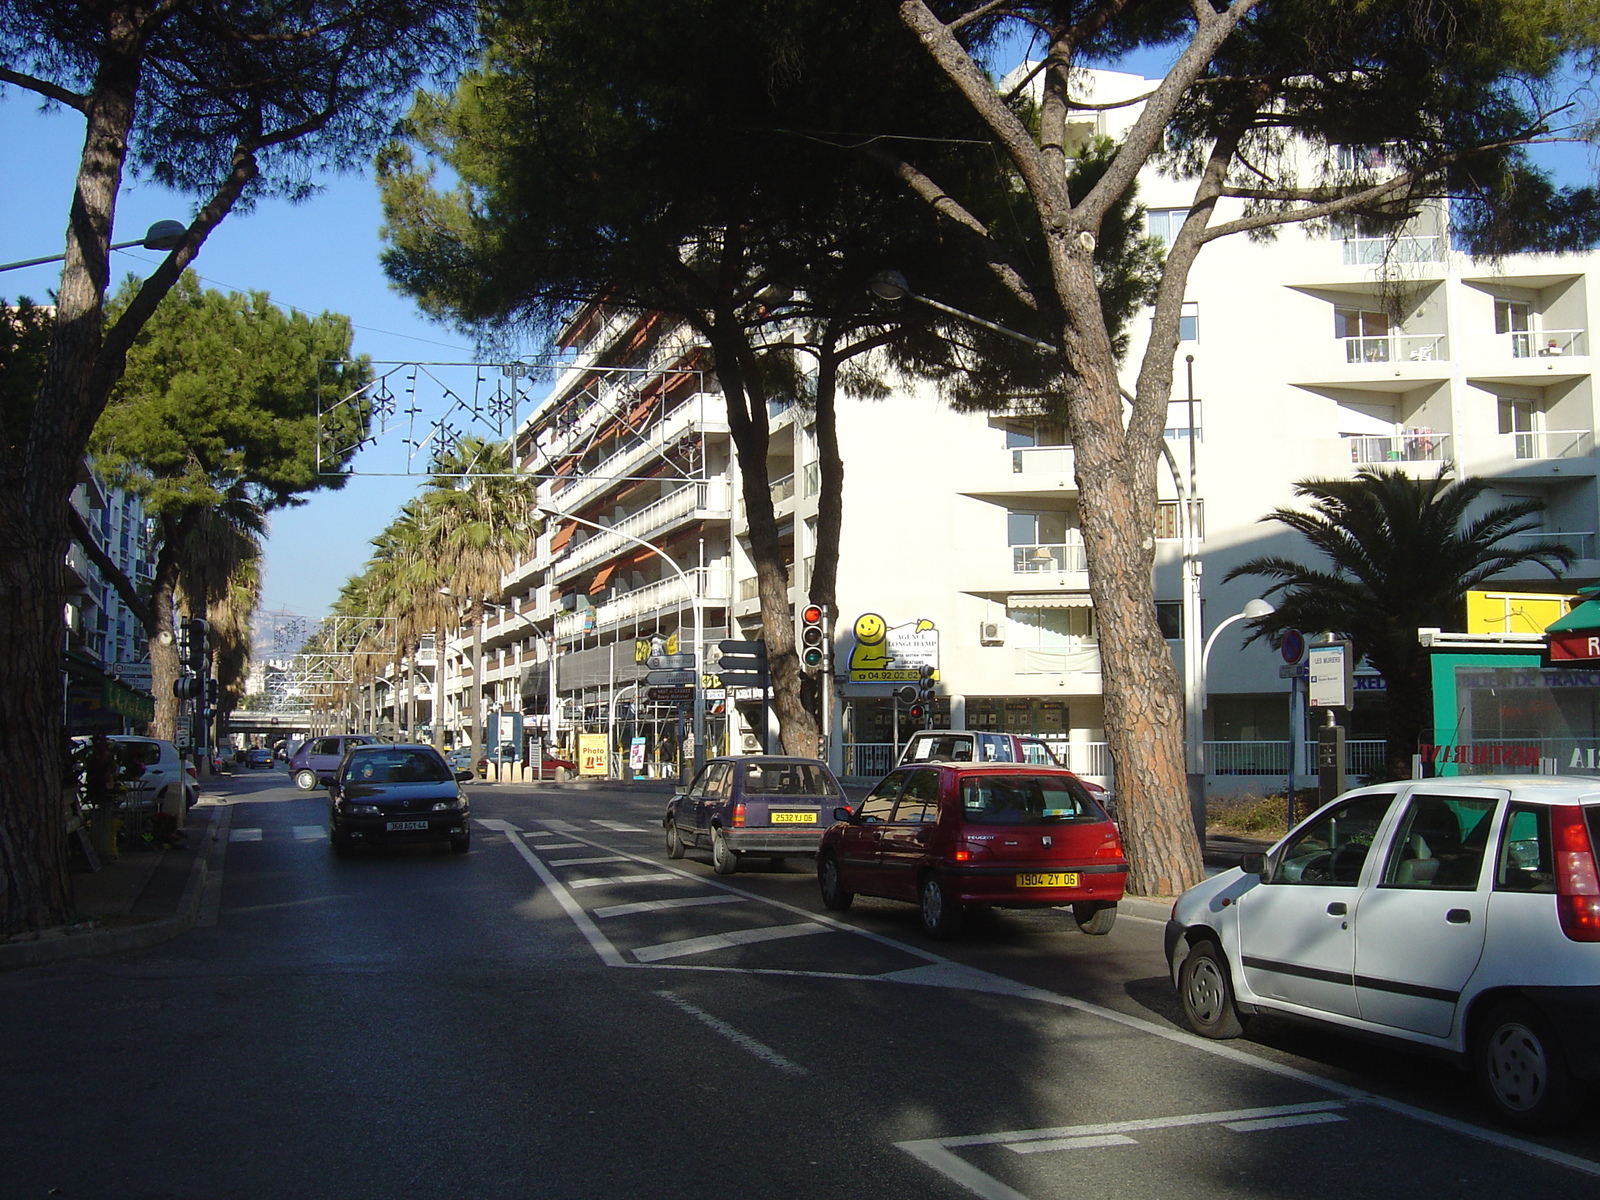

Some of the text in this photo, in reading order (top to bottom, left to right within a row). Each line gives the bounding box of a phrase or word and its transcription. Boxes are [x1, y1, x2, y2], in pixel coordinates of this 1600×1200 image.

[1314, 657, 1323, 665] LES
[775, 814, 794, 822] 2532
[803, 814, 813, 822] 06
[1019, 874, 1076, 886] 1904 ZY 06
